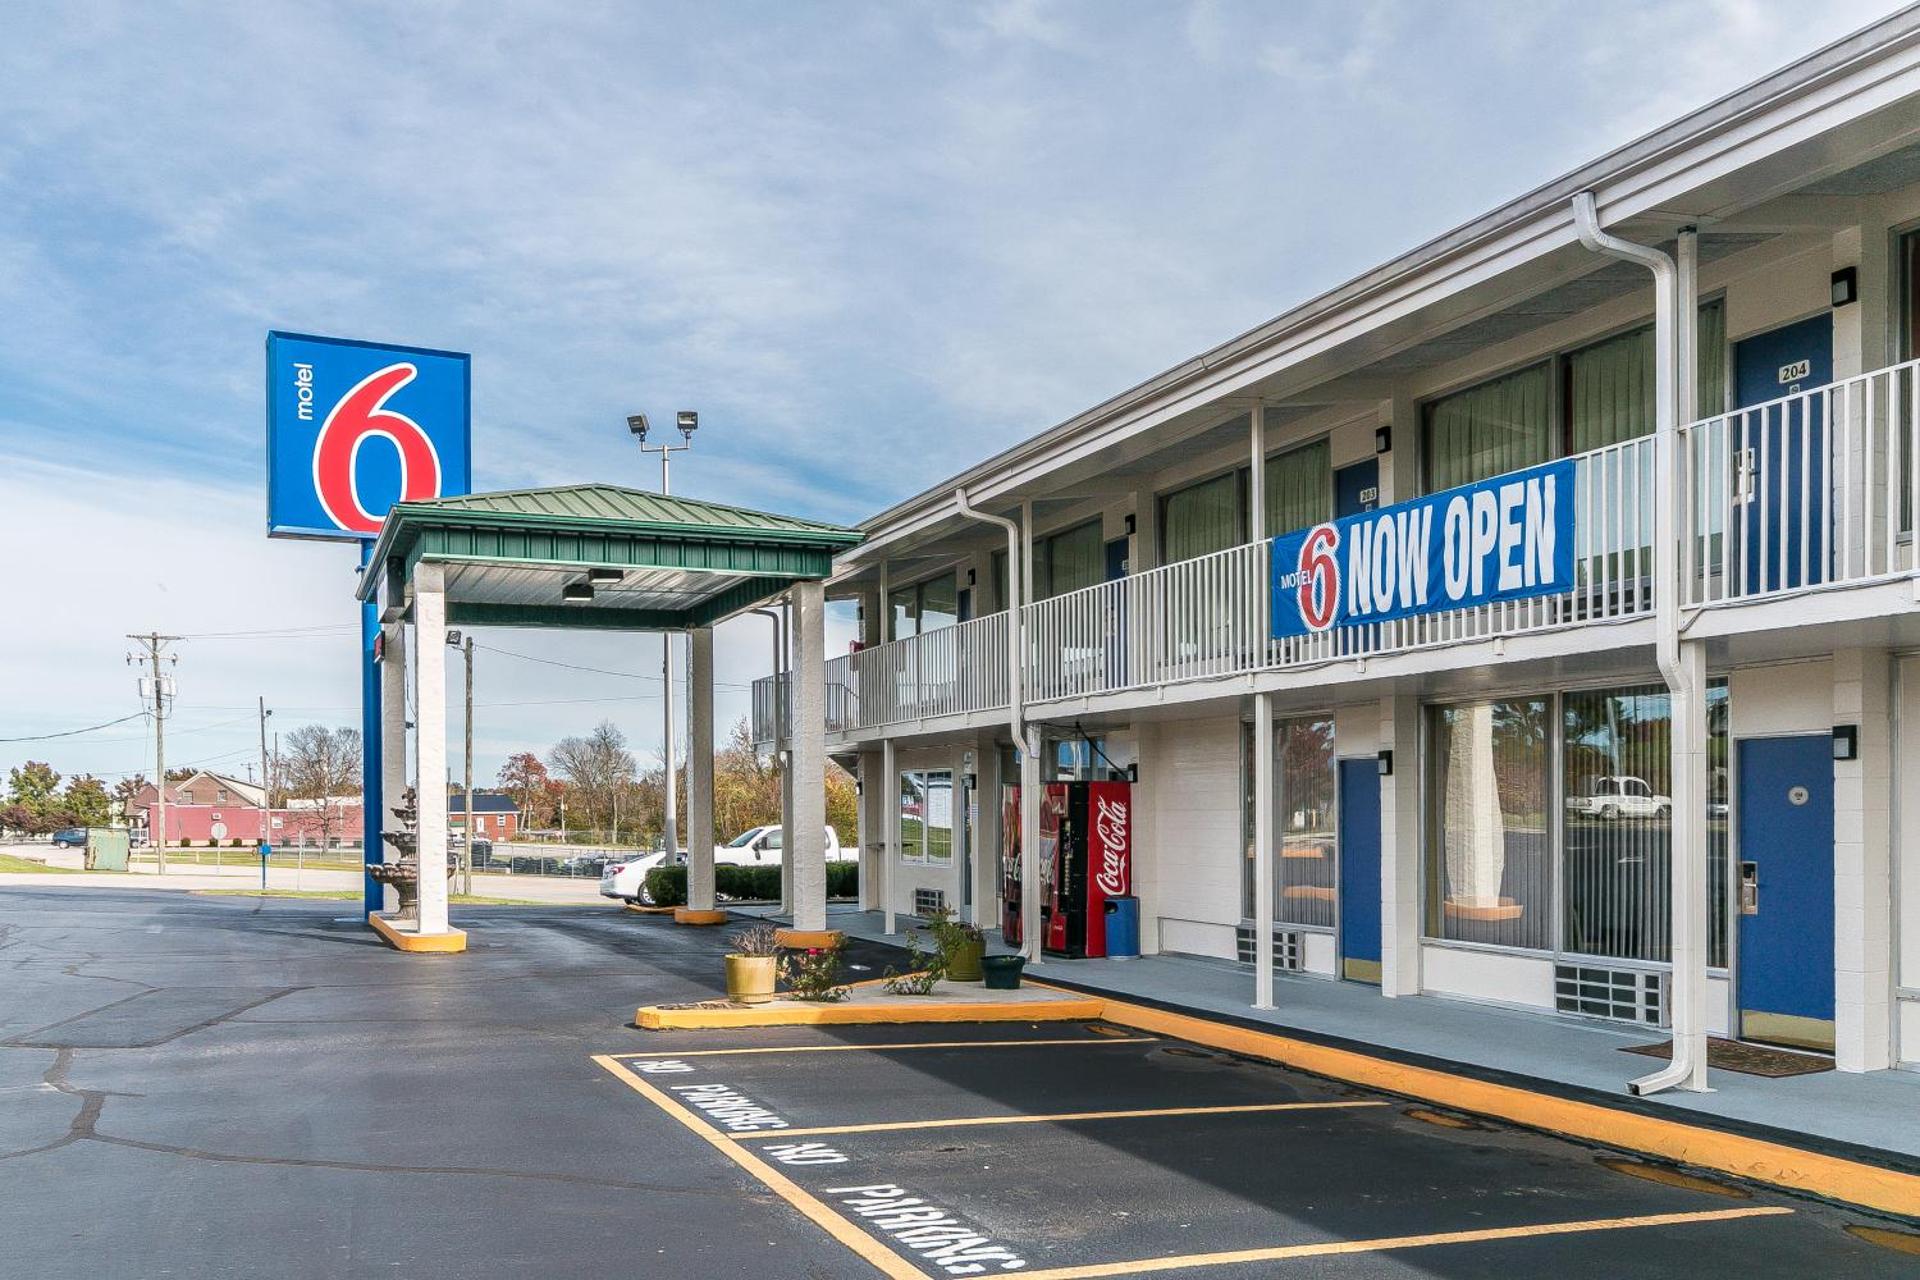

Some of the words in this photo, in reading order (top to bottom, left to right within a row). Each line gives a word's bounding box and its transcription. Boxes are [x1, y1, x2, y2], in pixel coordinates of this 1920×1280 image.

[294, 363, 313, 420] motel
[1783, 363, 1806, 380] 204
[312, 362, 442, 533] 6
[1349, 505, 1433, 616] NOW
[1444, 474, 1556, 600] OPEN
[1280, 568, 1312, 589] MOTEL
[1298, 522, 1340, 631] 6
[632, 1060, 696, 1073] NO
[670, 1084, 789, 1130] PARKING
[762, 1142, 849, 1165] NO
[825, 1183, 1026, 1274] PARKING
